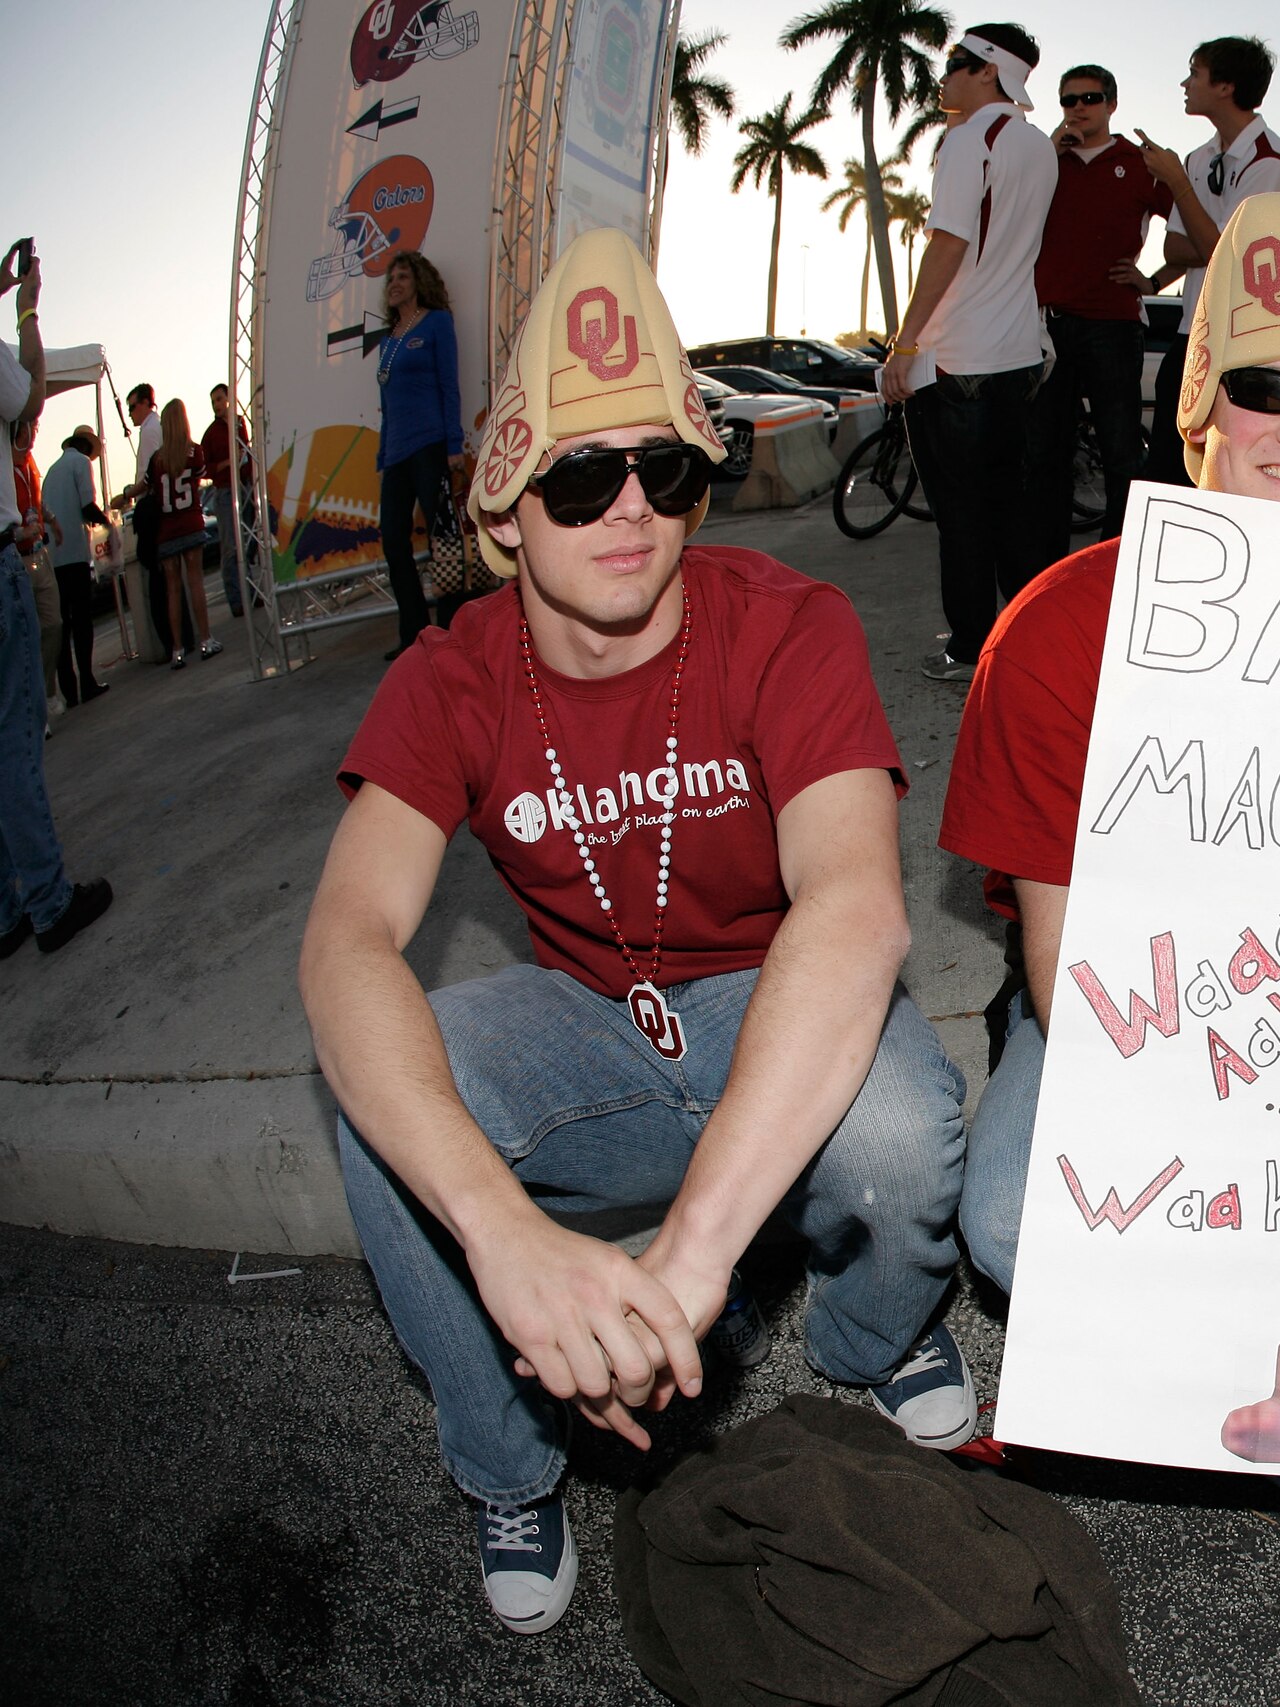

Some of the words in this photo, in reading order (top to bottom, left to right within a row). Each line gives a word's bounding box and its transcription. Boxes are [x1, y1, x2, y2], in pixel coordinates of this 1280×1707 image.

[373, 184, 425, 212] Gators
[567, 286, 640, 381] OU
[161, 469, 192, 513] 15
[588, 832, 607, 845] the
[610, 816, 630, 845] best
[682, 808, 701, 818] on
[628, 984, 688, 1062] OU
